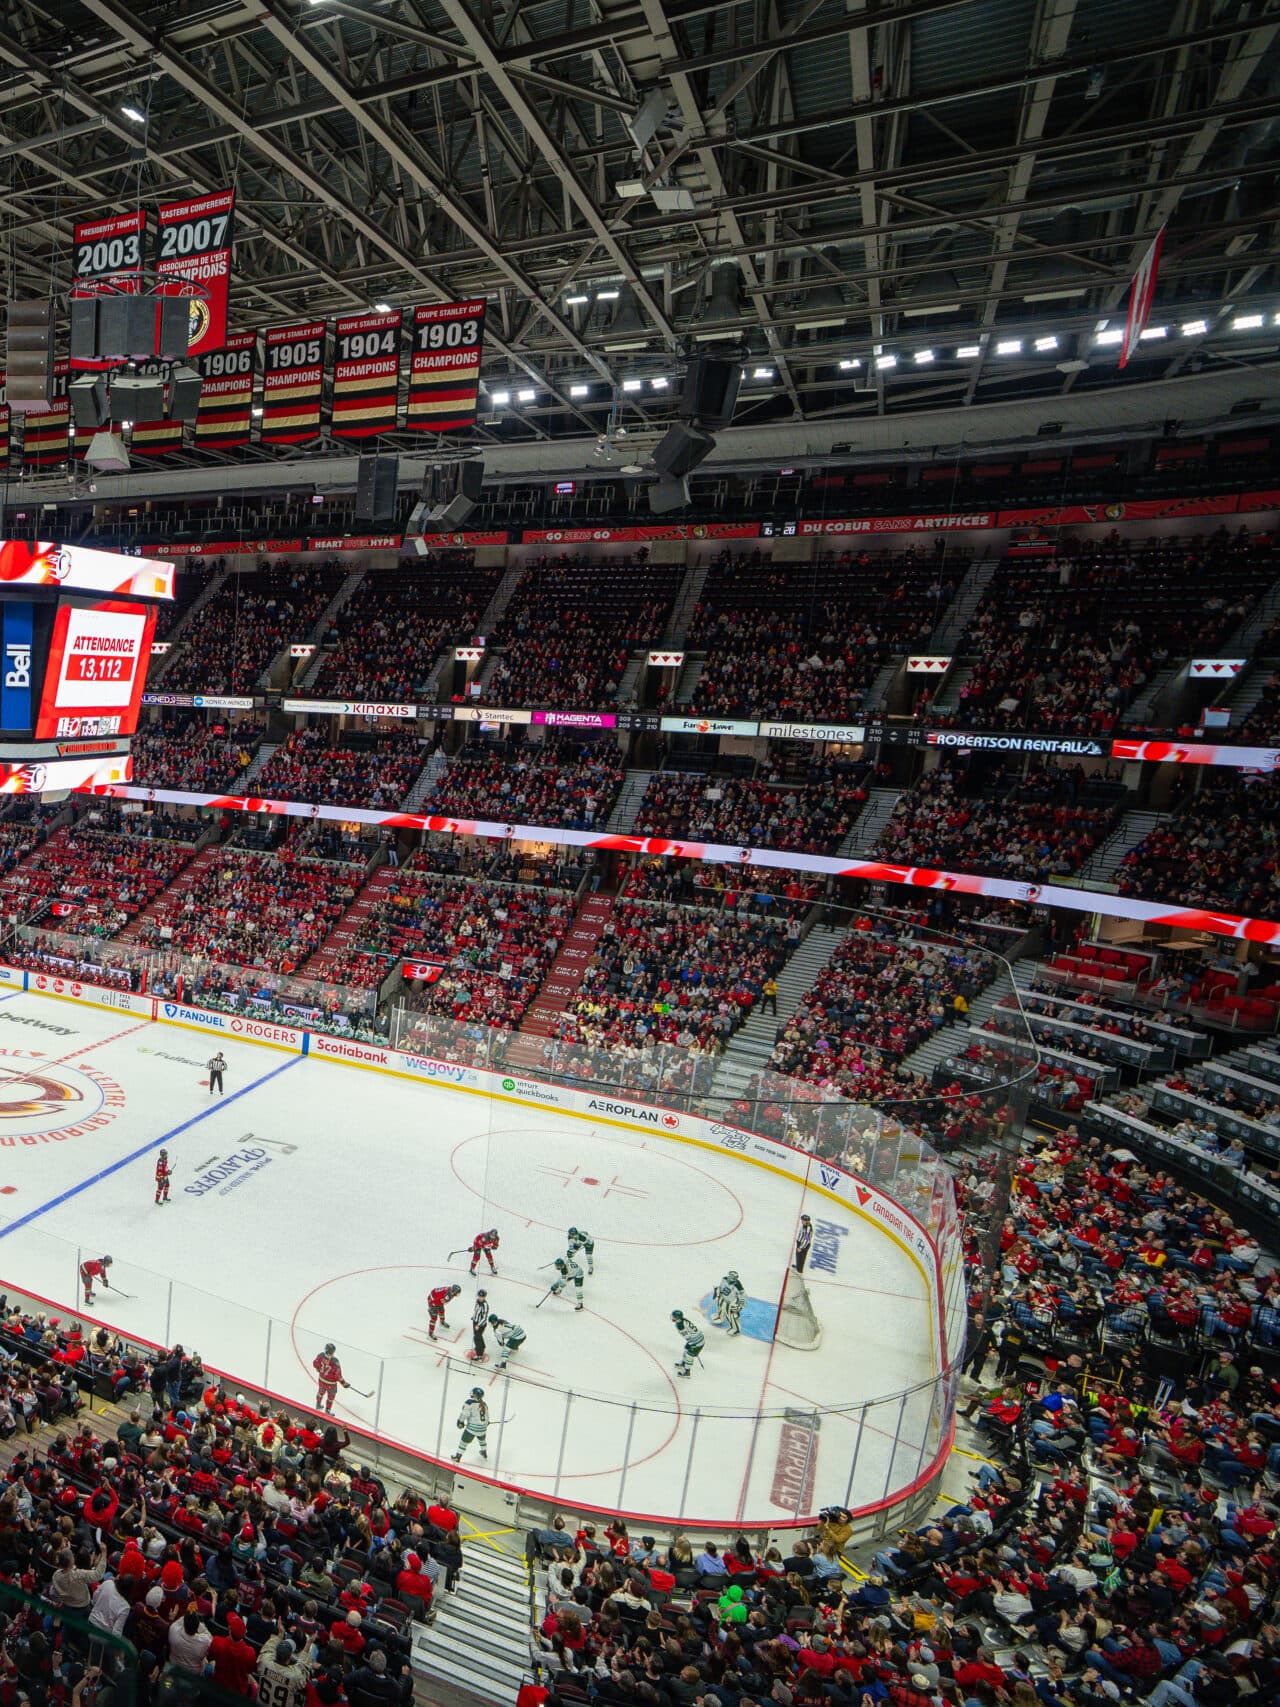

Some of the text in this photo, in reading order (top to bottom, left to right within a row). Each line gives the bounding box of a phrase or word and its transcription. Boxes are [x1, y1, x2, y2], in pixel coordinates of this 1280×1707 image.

[161, 196, 232, 219] EASTERN CONFERENCE
[80, 218, 140, 237] PRESIDENTS' TROPHY
[160, 215, 228, 257] 2007
[78, 235, 140, 274] 2003
[158, 258, 199, 272] ASSOCIATION
[200, 256, 209, 264] DE
[417, 304, 482, 319] COUPE STANLEY CUP
[339, 315, 400, 330] COUPE STANLEY CUP
[242, 336, 254, 345] CUP
[269, 326, 323, 341] COUPE STANLEY CUP
[418, 320, 478, 349] 1903
[270, 341, 320, 368] 1905
[340, 331, 395, 359] 1904
[203, 350, 251, 377] 1906
[337, 360, 396, 378] CHAMPIONS
[414, 352, 478, 368] CHAMPIONS
[201, 378, 251, 394] CHAMPIONS
[266, 369, 320, 386] CHAMPIONS
[803, 516, 989, 533] DU COEUR SANS ARTIFICES
[315, 541, 343, 549] HEART
[371, 538, 395, 547] HYPE
[546, 532, 562, 541] GO
[593, 530, 610, 539] GO
[190, 545, 202, 553] GO
[73, 635, 135, 653] ATTENDANCE
[5, 643, 31, 688] Bell
[79, 657, 123, 681] 13,112
[484, 710, 514, 721] Stantec
[556, 713, 602, 723] MAGENTA
[769, 725, 854, 741] milestones
[937, 734, 1084, 753] ROBERTSON RENT-ALL
[180, 1009, 225, 1027] FANDUEL
[246, 1022, 296, 1044] ROGERS
[317, 1039, 388, 1065] Scotiabank
[405, 1056, 467, 1081] wegovy
[91, 1070, 127, 1109] CENTRE
[516, 1088, 559, 1102] quickbooks
[588, 1099, 659, 1123] AEROPLAN
[0, 1111, 118, 1147] CANADIAN
[184, 1147, 266, 1197] PLAYOFFS
[873, 1201, 915, 1242] CANADIAN TIRE
[260, 1677, 289, 1707] 69
